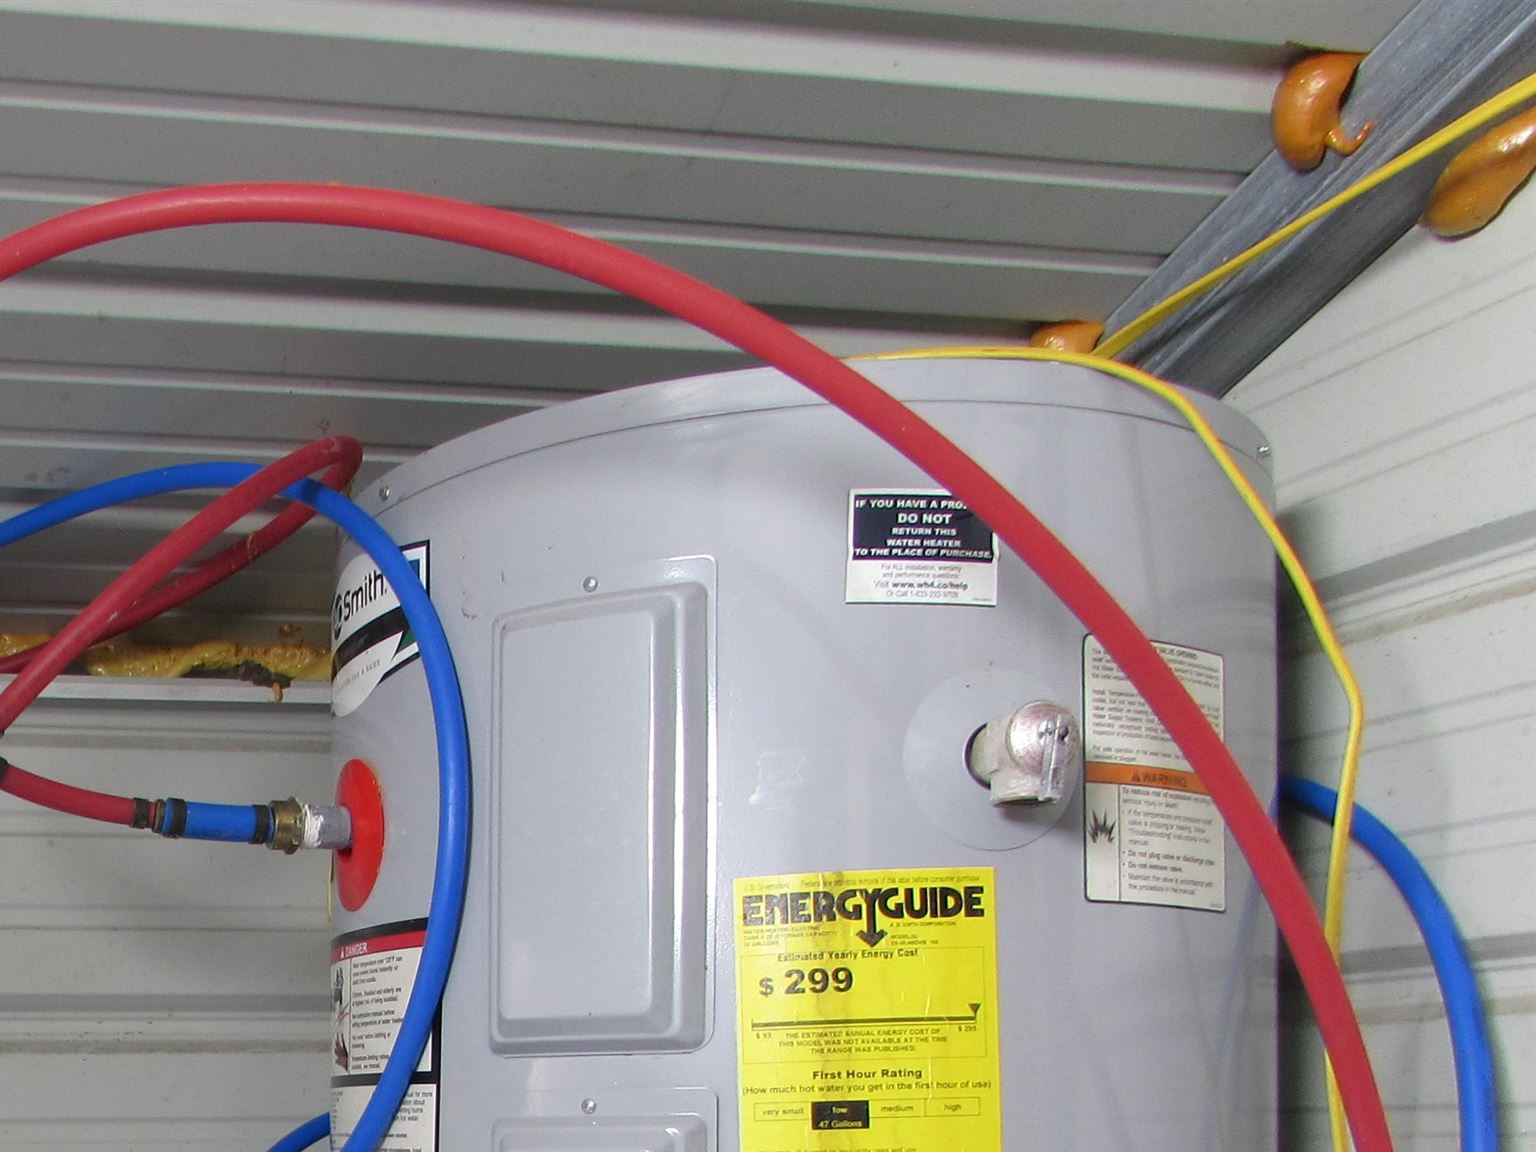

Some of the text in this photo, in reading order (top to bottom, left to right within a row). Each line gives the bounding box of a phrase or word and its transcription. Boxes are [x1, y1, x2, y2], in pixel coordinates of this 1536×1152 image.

[855, 499, 866, 508] IF
[869, 499, 893, 508] YOU
[896, 499, 927, 509] HAVE
[929, 500, 938, 509] A
[897, 513, 953, 524] DO NOT
[891, 527, 957, 536] RETURN THIS
[886, 538, 962, 548] WATER HEATER
[854, 548, 993, 559] TO THE PLACE OF PURCHASE.
[1141, 772, 1189, 788] WARNING
[742, 886, 985, 927] ENERGYGUIDE
[777, 948, 919, 963] Estimated Yearly Energy Cost
[759, 966, 854, 998] $ 299
[801, 1030, 843, 1039] ESTIMATED
[876, 1029, 909, 1037] ENERGY
[909, 1028, 929, 1036] COST
[842, 1038, 859, 1046] NOT
[860, 1037, 902, 1045] AVAILABLE
[826, 1046, 853, 1054] RANGE
[811, 1068, 923, 1080] First Hour Rating
[742, 1085, 767, 1096] (How
[769, 1085, 797, 1094] much
[799, 1084, 815, 1093] hot
[818, 1084, 845, 1092] water
[847, 1083, 865, 1094] you
[868, 1083, 883, 1093] get
[885, 1082, 895, 1090] in
[897, 1081, 913, 1090] the
[936, 1081, 958, 1089] hour
[959, 1080, 970, 1088] of
[971, 1080, 992, 1090] use)
[762, 1108, 779, 1117] very
[782, 1107, 804, 1116] small
[880, 1104, 914, 1114] medium
[943, 1103, 963, 1114] high
[830, 1119, 863, 1129] Gallons
